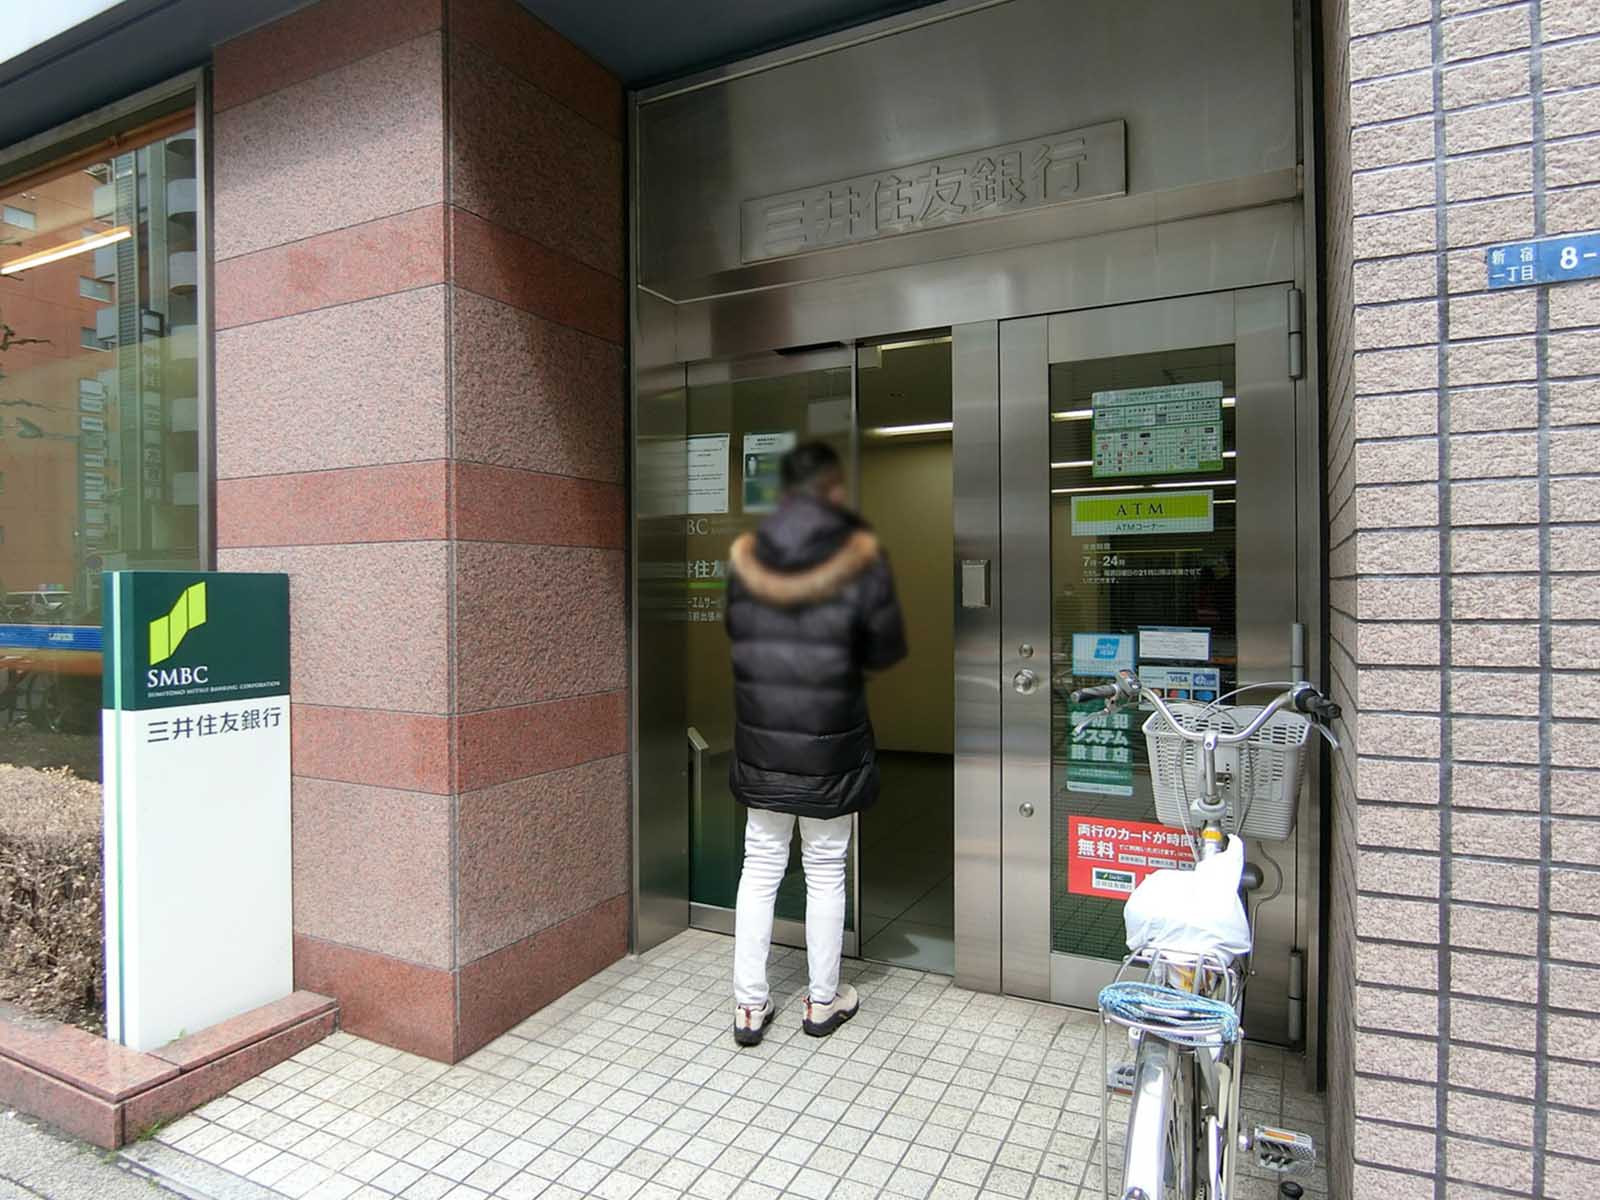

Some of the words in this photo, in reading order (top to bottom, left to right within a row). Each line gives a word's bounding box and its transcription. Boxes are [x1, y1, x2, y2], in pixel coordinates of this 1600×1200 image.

[764, 135, 1088, 252] 三井住友銀行
[1491, 246, 1534, 265] 新宿
[1491, 265, 1534, 282] 一丁目
[1115, 502, 1165, 517] ATM
[1115, 521, 1167, 532] ATMコーナー
[147, 666, 209, 688] SMBC
[210, 684, 239, 693] BANKING
[239, 680, 281, 690] CORPORATION
[147, 706, 282, 743] 三井住友銀行
[1077, 823, 1201, 848] 両行のカードが時間
[1077, 838, 1115, 860] 無料
